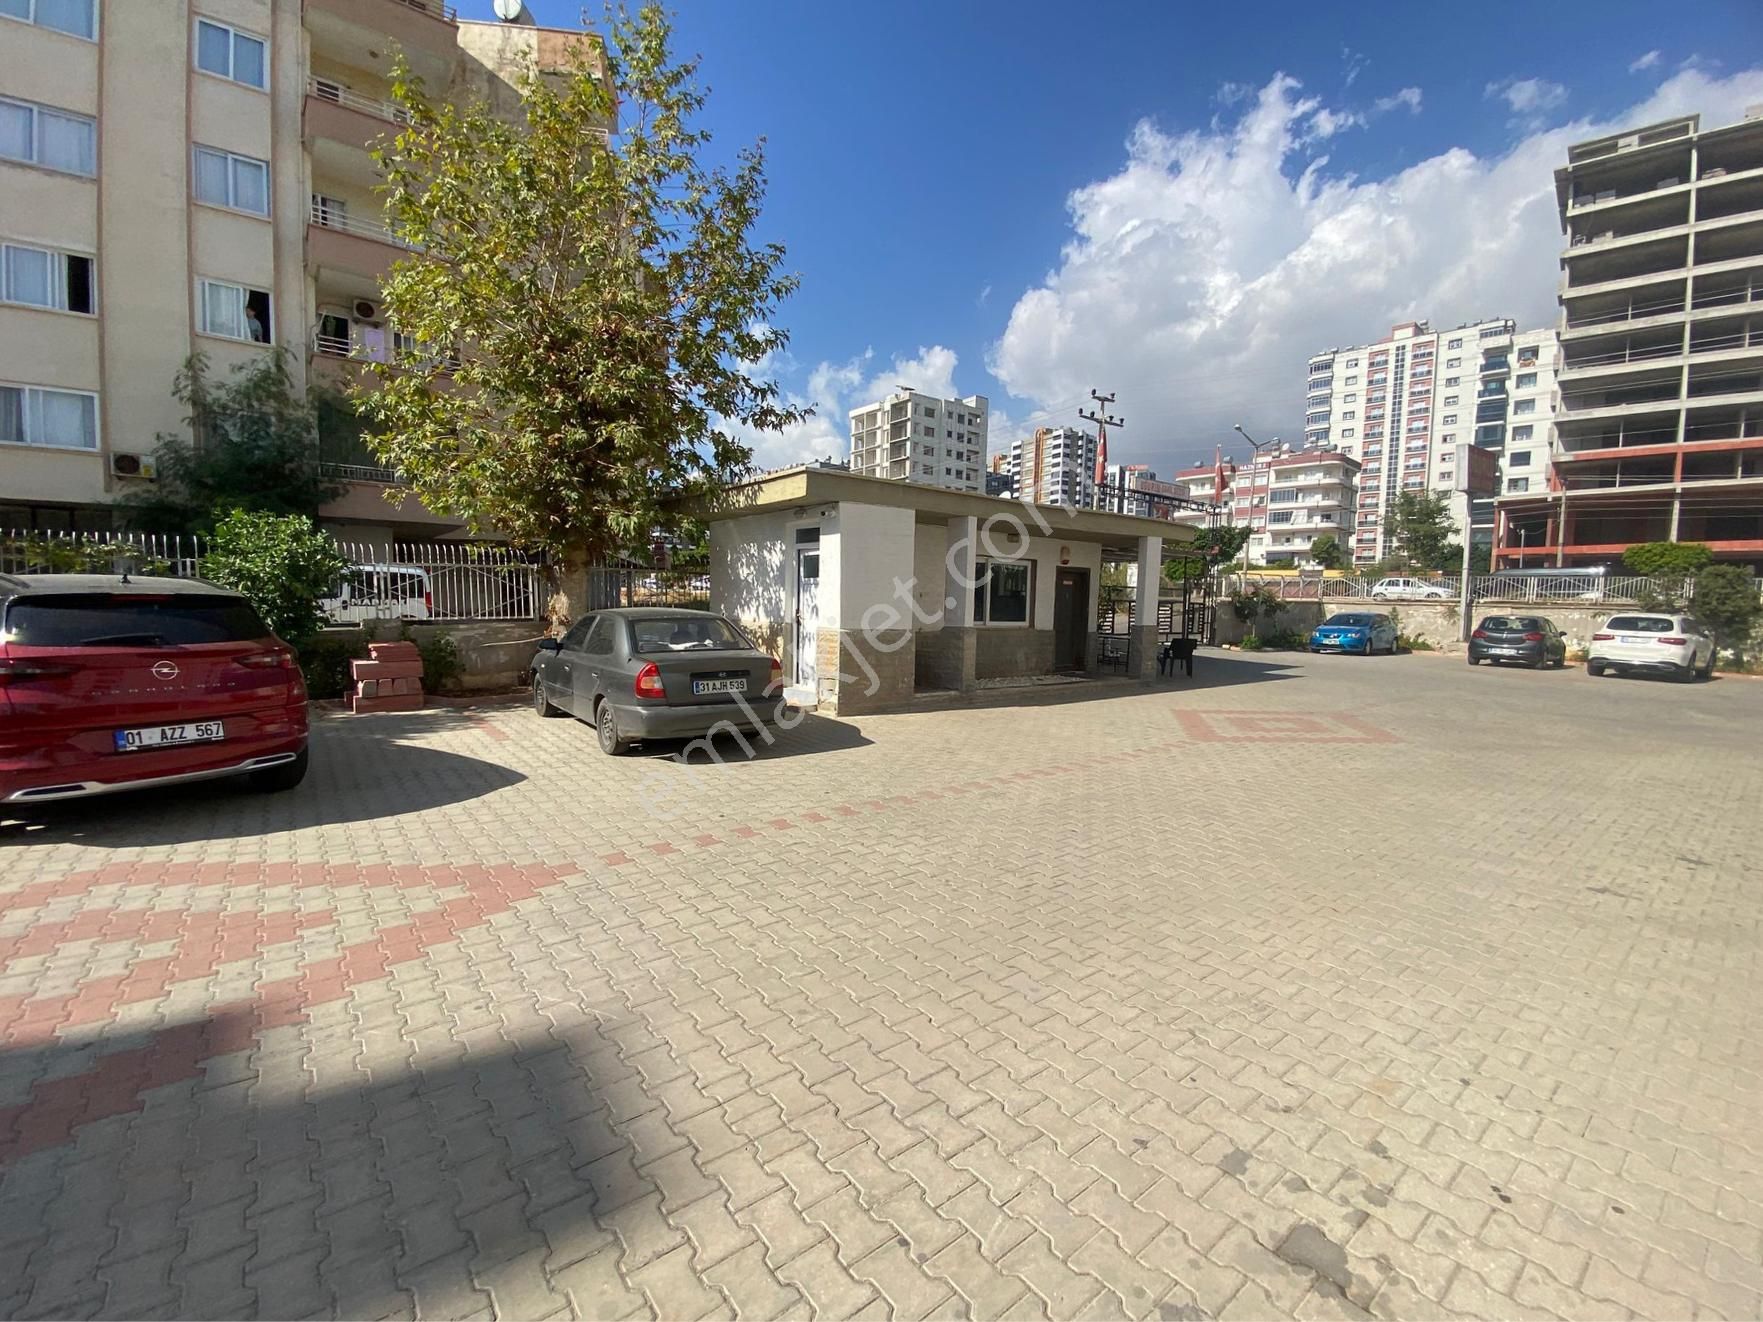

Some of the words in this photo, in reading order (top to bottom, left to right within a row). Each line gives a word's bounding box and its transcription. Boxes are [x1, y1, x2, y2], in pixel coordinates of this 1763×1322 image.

[700, 682, 710, 691] 31
[712, 681, 728, 691] AJH
[729, 680, 745, 690] 539
[125, 730, 143, 745] 01
[160, 726, 187, 742] AZZ
[195, 722, 221, 738] 567
